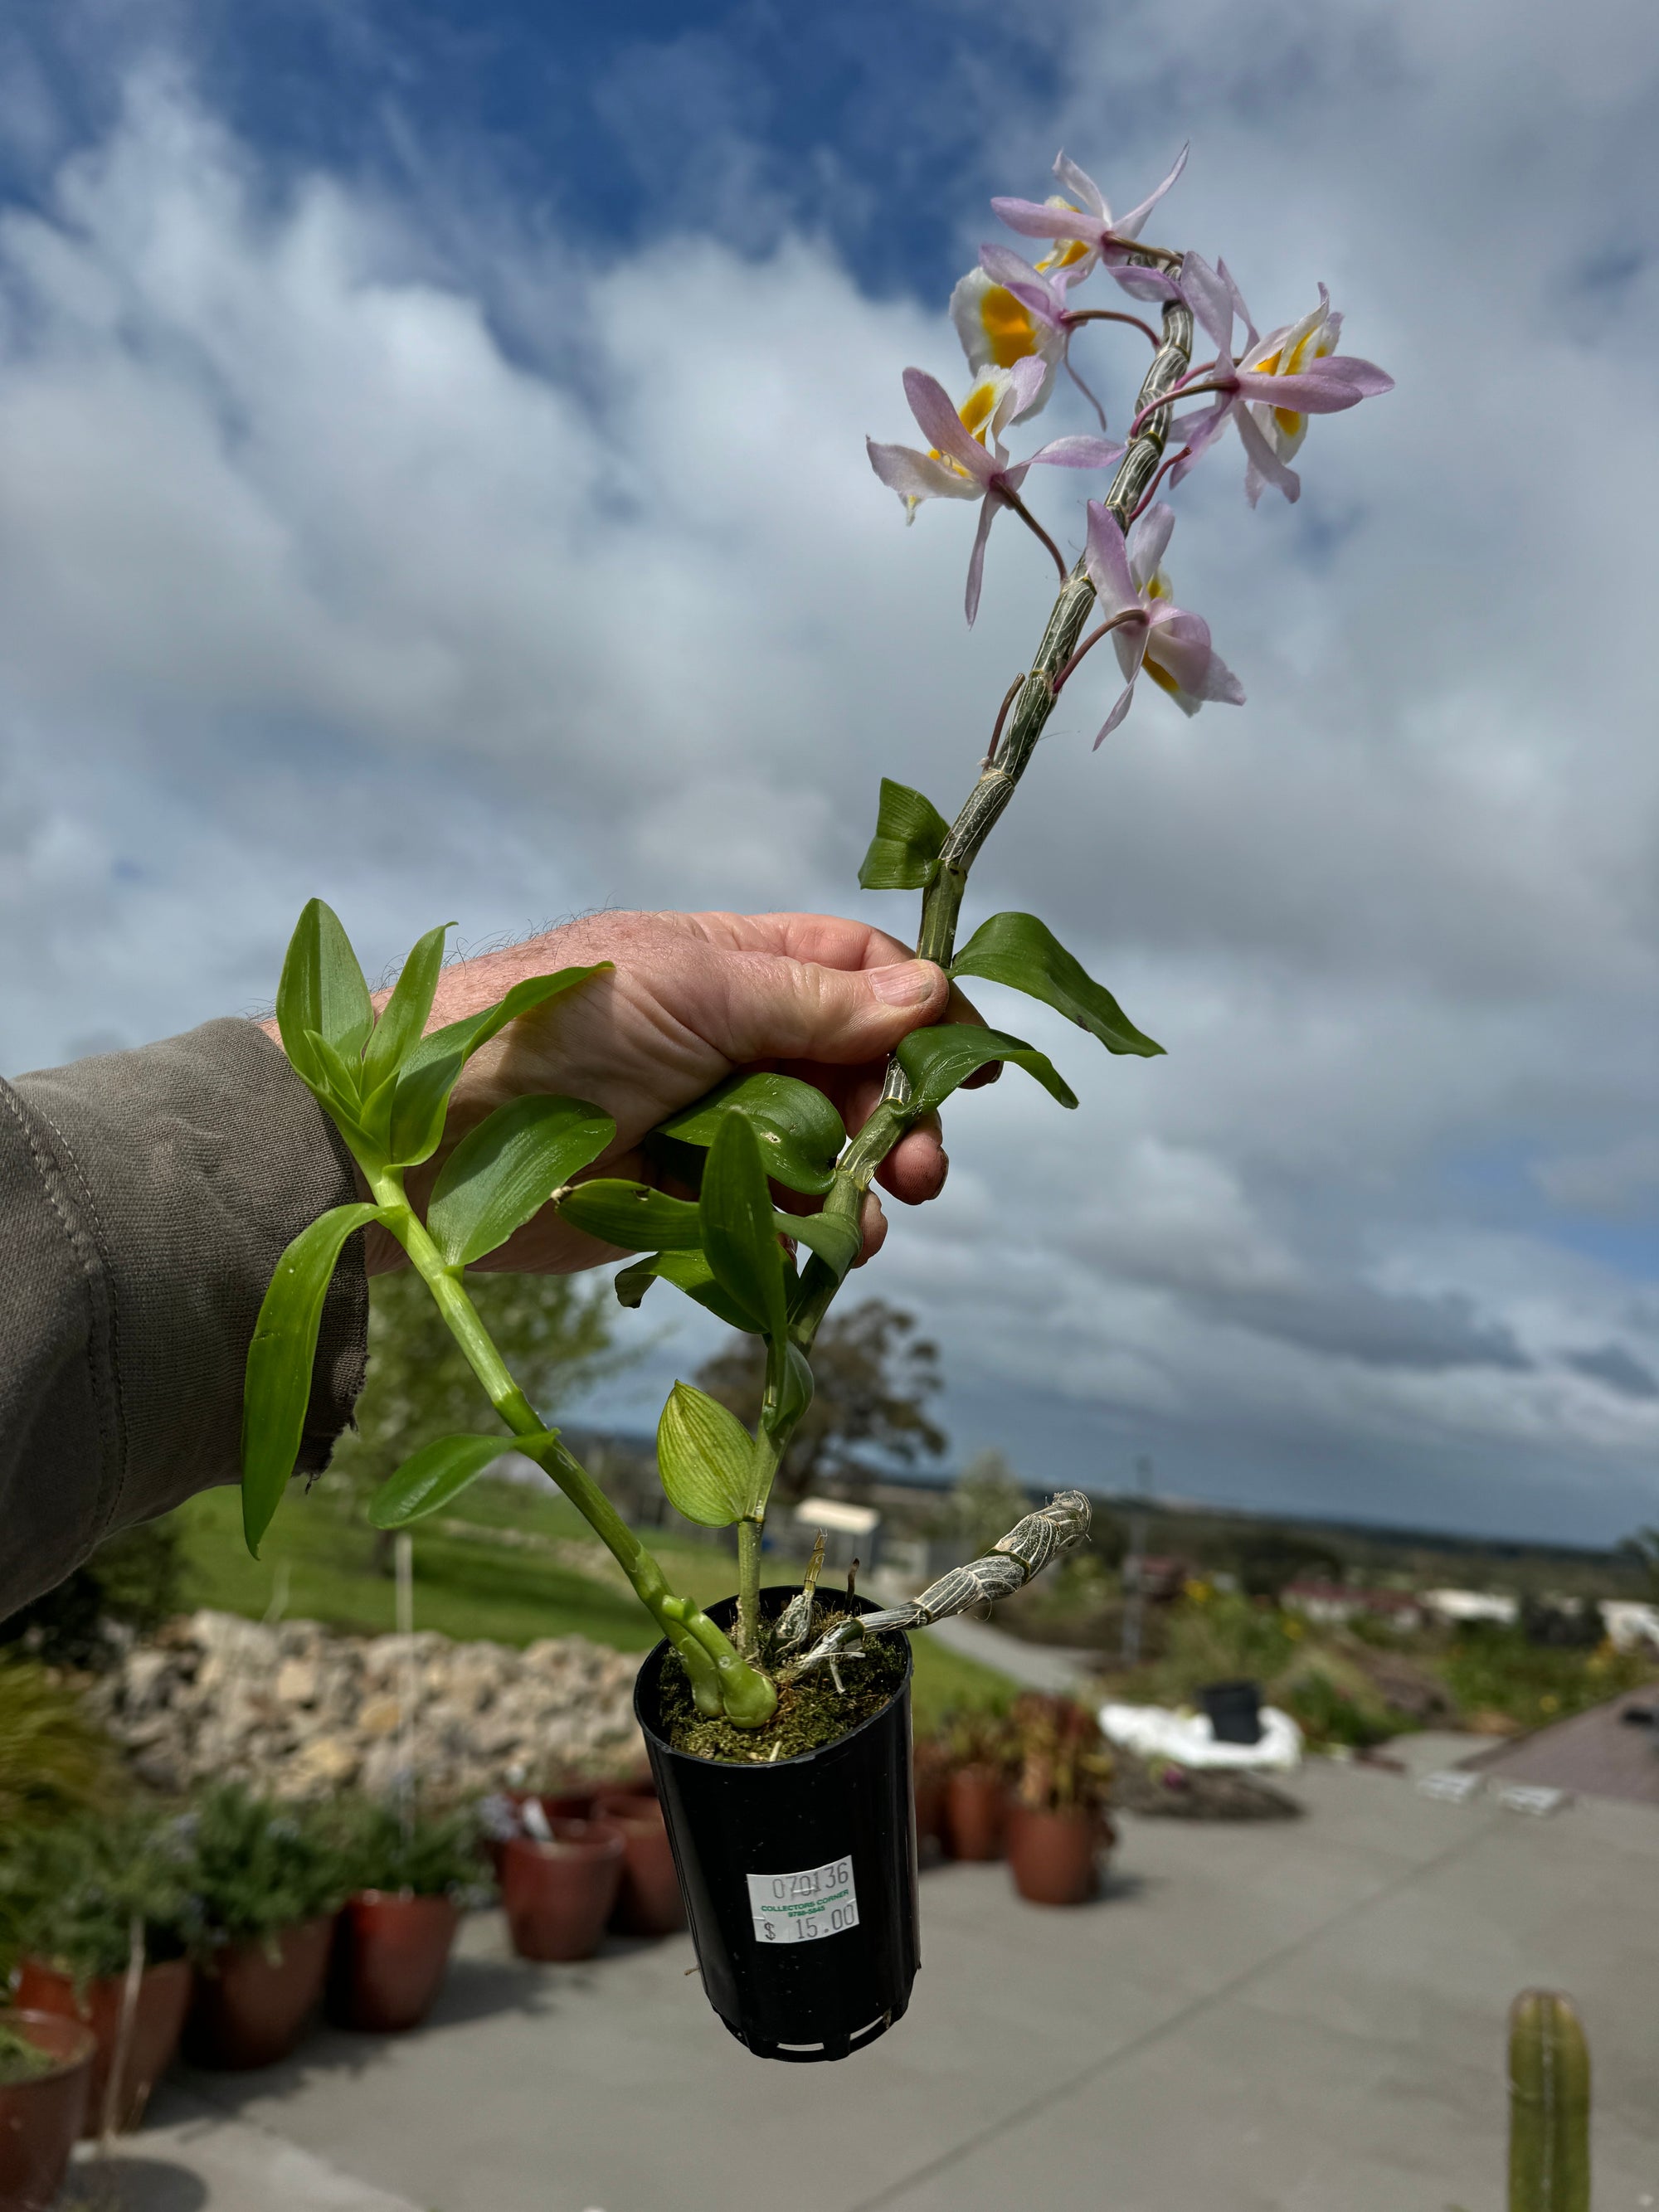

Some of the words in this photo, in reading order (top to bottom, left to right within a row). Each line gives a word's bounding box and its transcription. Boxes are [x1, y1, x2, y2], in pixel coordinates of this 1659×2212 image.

[772, 1862, 849, 1899] 070136
[761, 1902, 815, 1912] COLLECTORS
[816, 1889, 849, 1905] CORNER
[764, 1922, 776, 1941] $
[795, 1904, 854, 1939] 15.00
